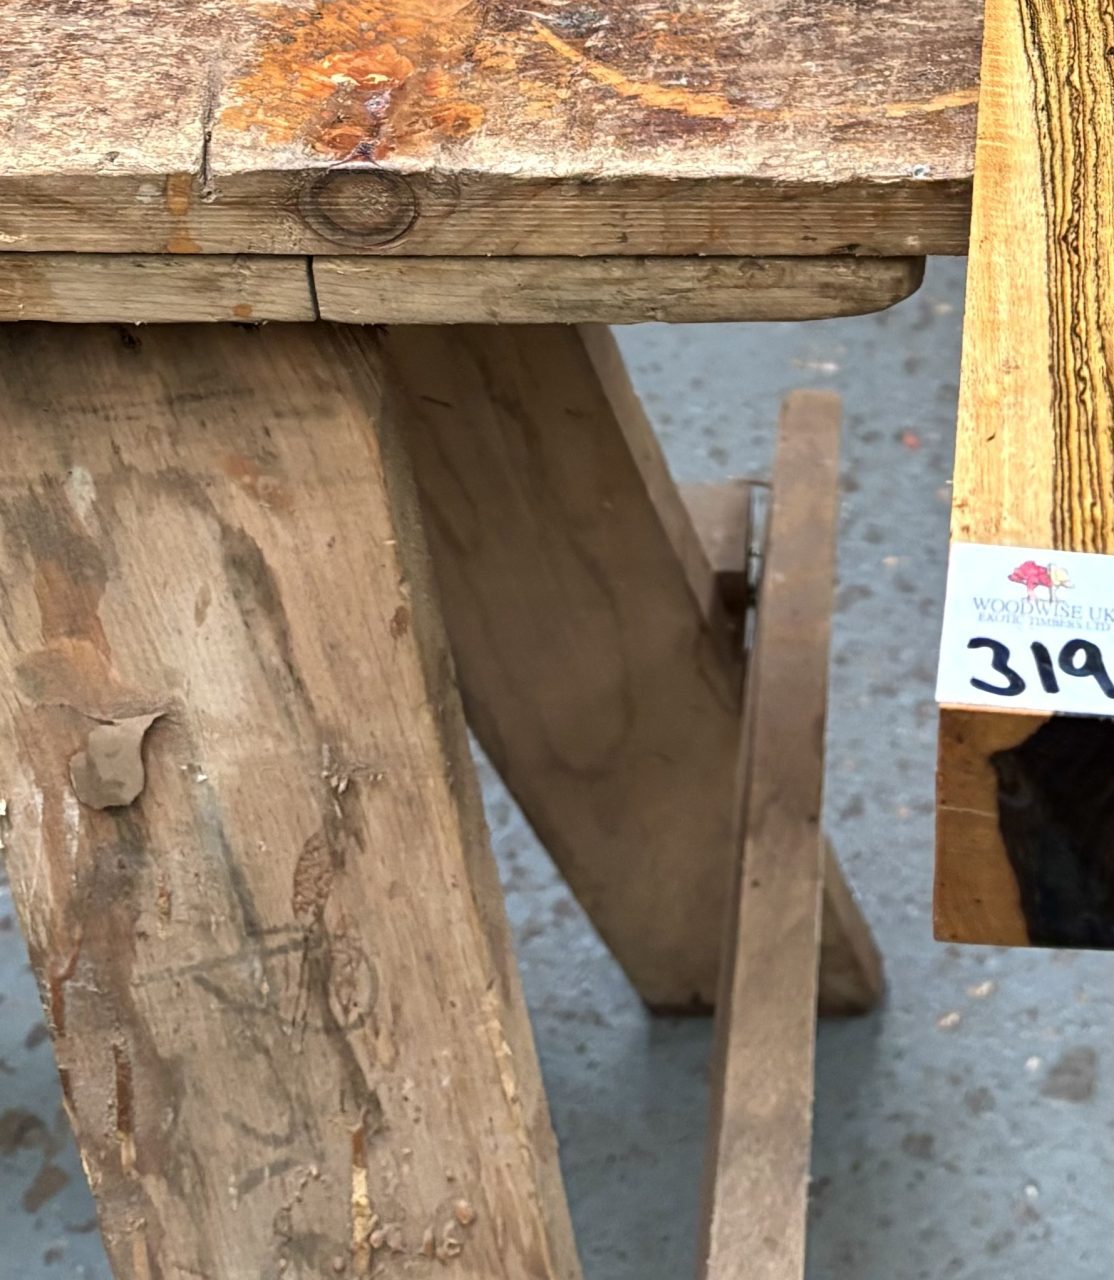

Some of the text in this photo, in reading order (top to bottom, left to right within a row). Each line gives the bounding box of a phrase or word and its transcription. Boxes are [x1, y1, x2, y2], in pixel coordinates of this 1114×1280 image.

[973, 597, 1082, 619] WOODWISE
[1029, 617, 1082, 630] TIMBERS
[1086, 621, 1111, 631] LTD
